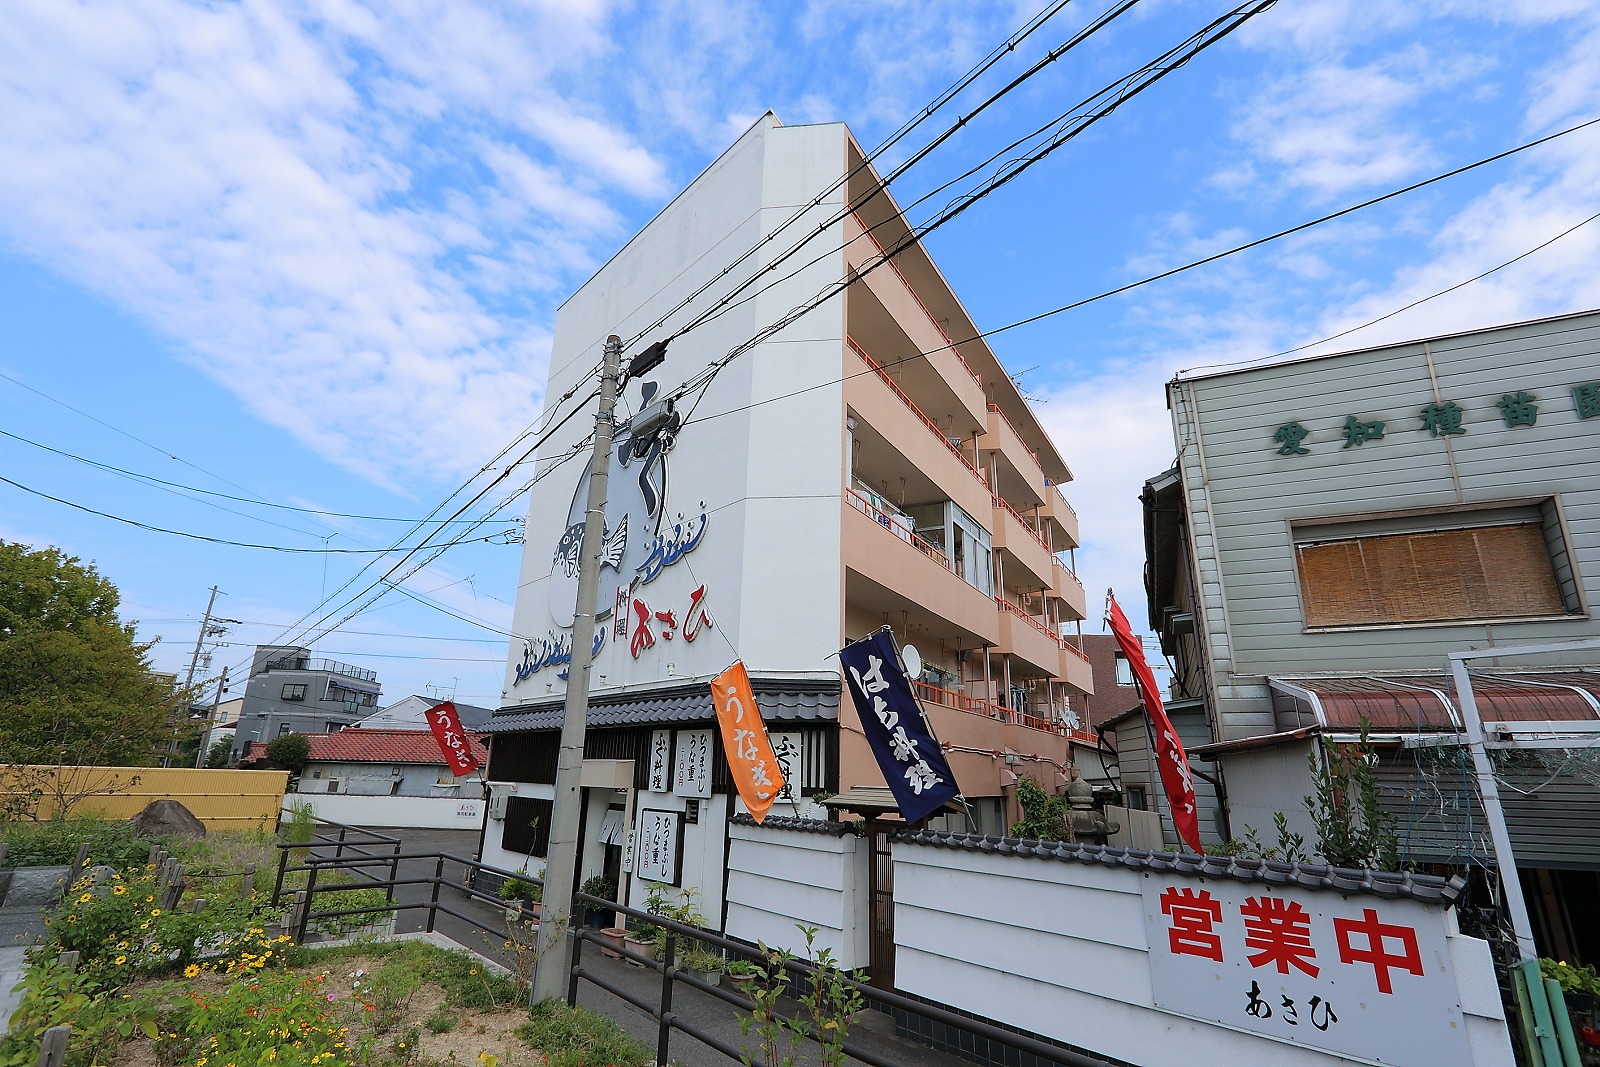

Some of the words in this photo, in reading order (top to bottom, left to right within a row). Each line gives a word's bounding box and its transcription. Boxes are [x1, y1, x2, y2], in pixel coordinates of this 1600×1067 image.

[631, 584, 712, 659] あさひ
[653, 732, 667, 789] ふぐ料理
[687, 733, 696, 782] うな重
[698, 733, 707, 793] ひつまぶし
[726, 686, 772, 799] うなぎ
[652, 815, 660, 864] うな重
[662, 816, 671, 877] ひつまぶし
[1160, 887, 1425, 995] 営業中
[1245, 980, 1338, 1032] あさひ
